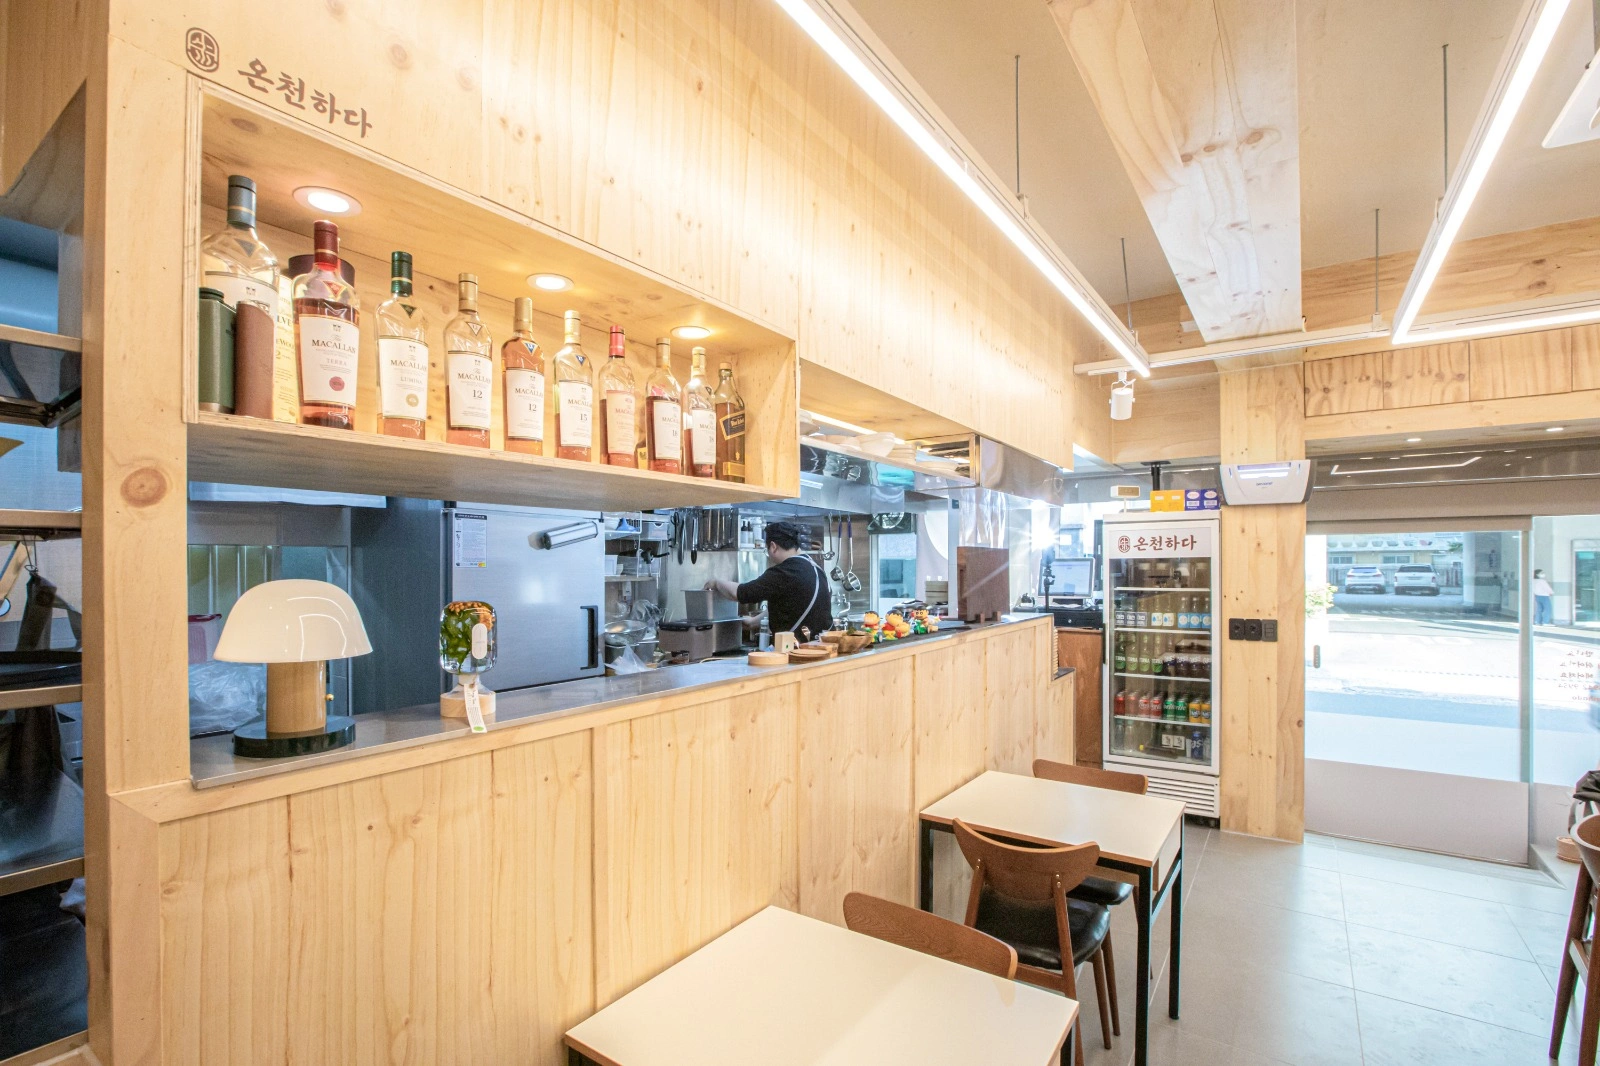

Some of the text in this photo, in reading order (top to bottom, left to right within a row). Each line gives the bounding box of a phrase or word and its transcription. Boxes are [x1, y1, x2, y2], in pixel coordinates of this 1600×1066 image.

[237, 57, 373, 139] 온천하다
[472, 389, 483, 399] 12
[528, 403, 537, 412] 12
[580, 413, 588, 422] 15
[1133, 534, 1197, 552] 온천하다
